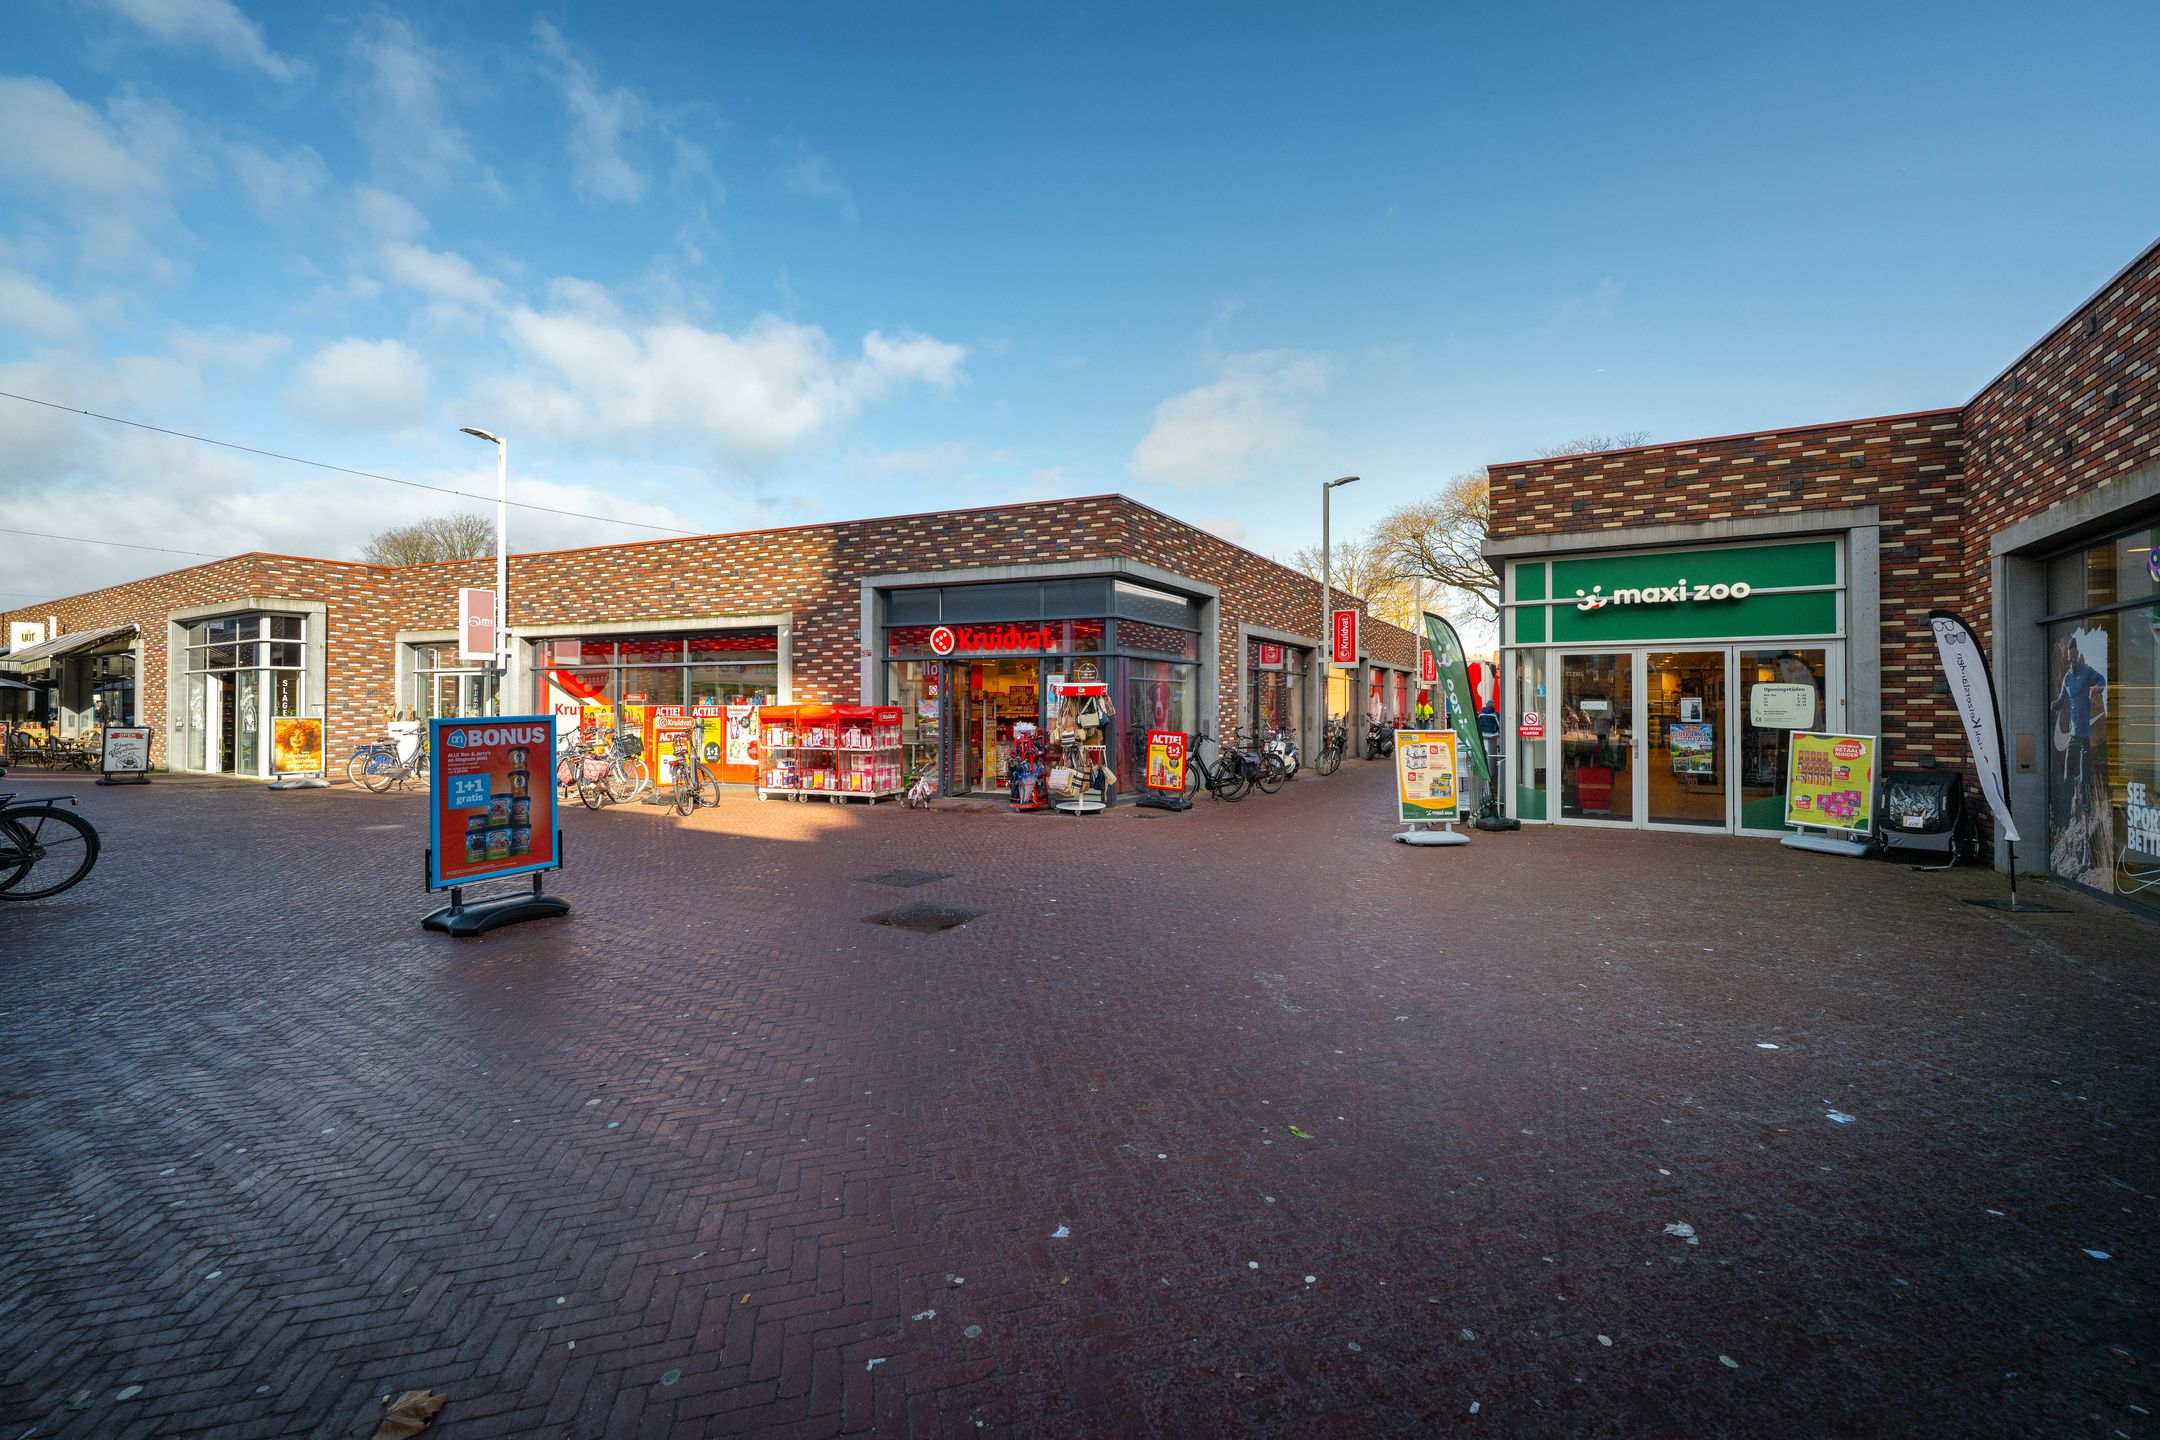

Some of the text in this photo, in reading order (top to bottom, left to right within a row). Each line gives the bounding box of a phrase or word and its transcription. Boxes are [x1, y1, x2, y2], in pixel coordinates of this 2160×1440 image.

[1613, 578, 1751, 605] maxi zoo
[959, 626, 1053, 651] Kruidvat
[1340, 617, 1349, 650] Kruidvat
[655, 707, 681, 717] ACTIE!
[692, 707, 719, 717] ACTIE!
[667, 717, 693, 727] Kruidvat
[468, 727, 545, 747] BONUS
[1152, 734, 1182, 745] ACTIE!
[706, 746, 719, 756] 1+1
[1168, 746, 1180, 754] 1+1
[455, 778, 484, 794] 1+1
[456, 793, 483, 805] gratis
[2127, 781, 2146, 806] SEE
[2127, 804, 2160, 833] SPOR
